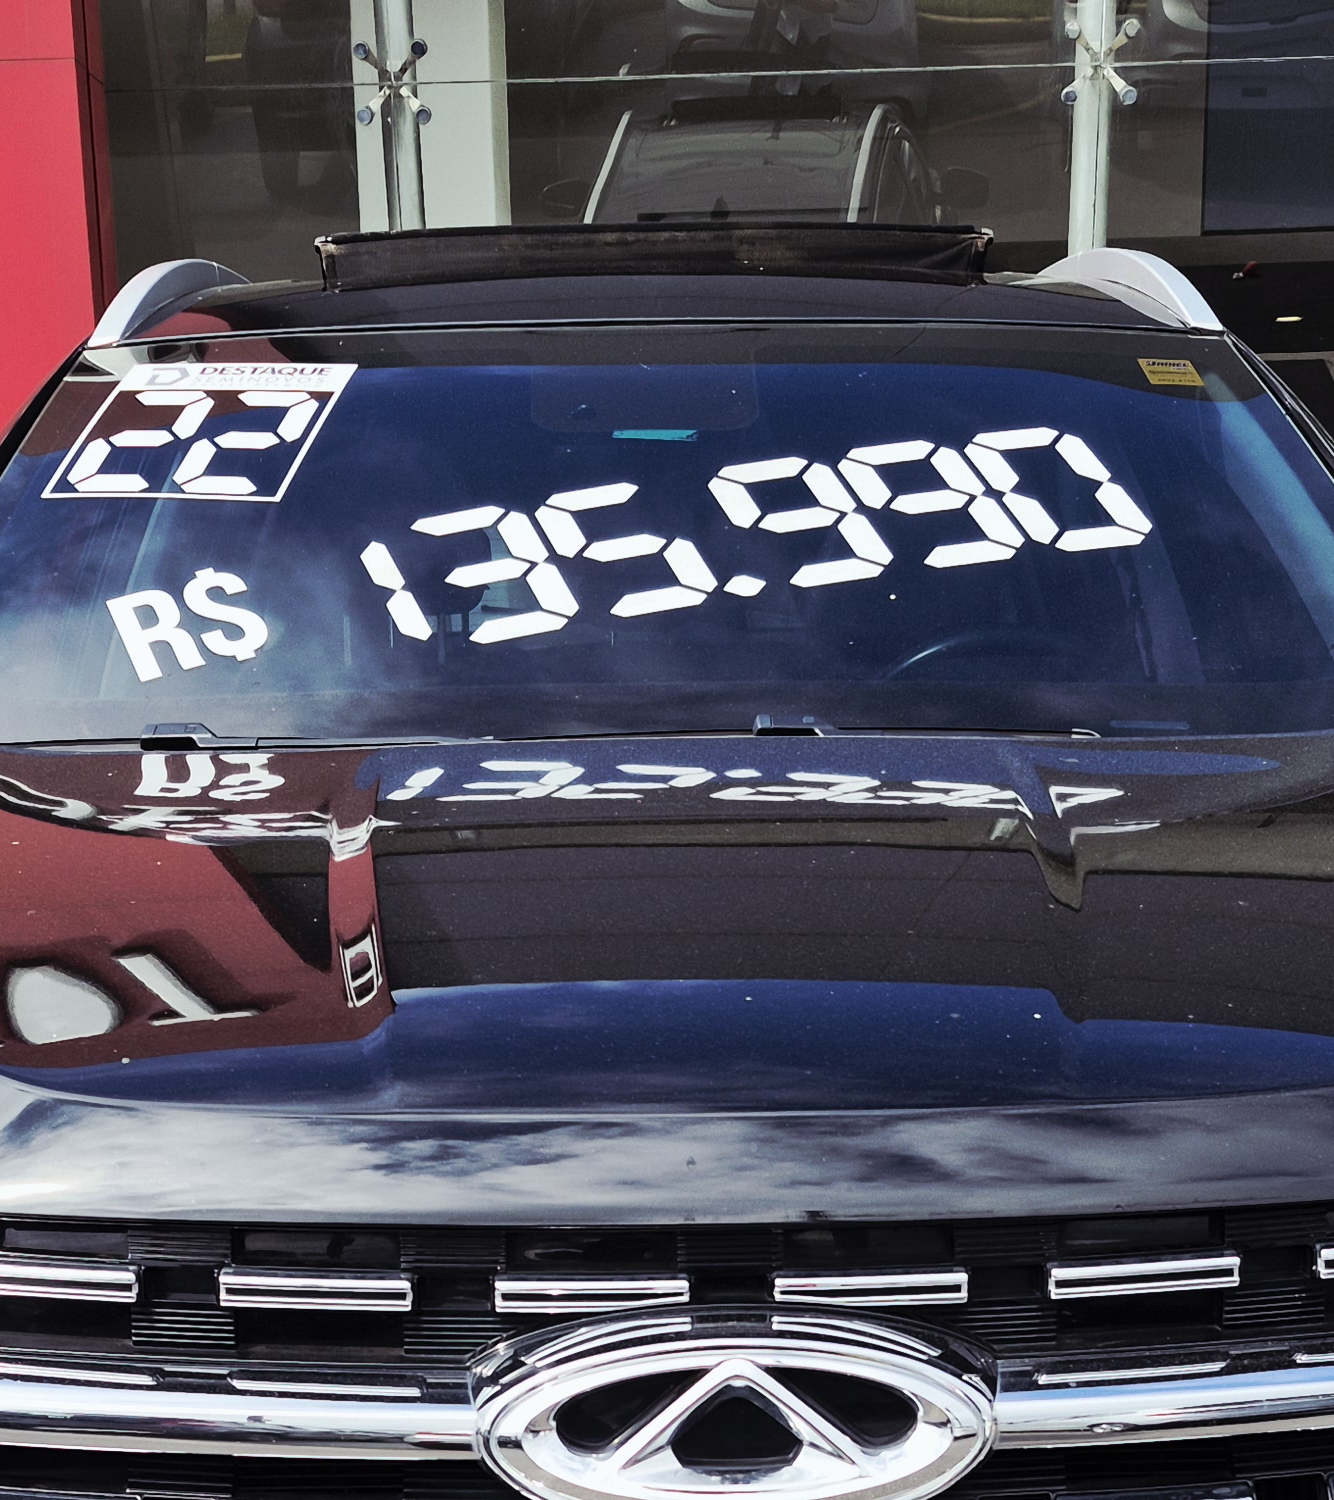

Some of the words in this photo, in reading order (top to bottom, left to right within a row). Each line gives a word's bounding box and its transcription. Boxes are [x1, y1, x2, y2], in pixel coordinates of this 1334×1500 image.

[200, 367, 332, 375] DESTAQUE
[66, 390, 320, 496] 22
[105, 568, 269, 682] R$
[358, 426, 1153, 645] 135.990
